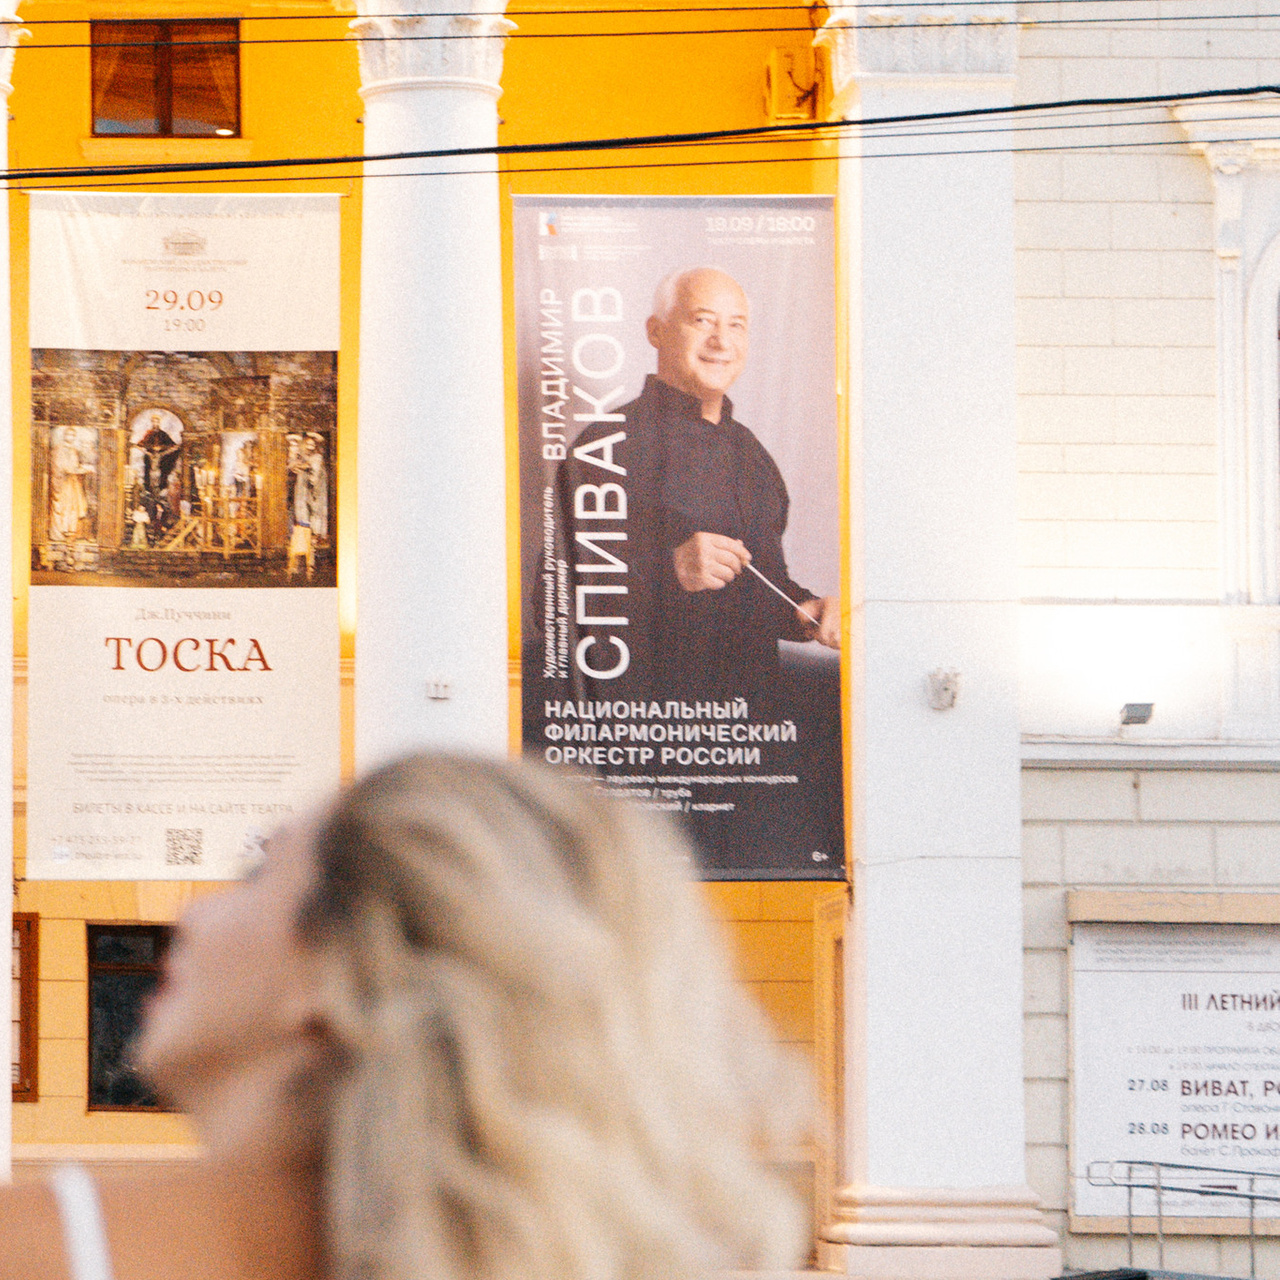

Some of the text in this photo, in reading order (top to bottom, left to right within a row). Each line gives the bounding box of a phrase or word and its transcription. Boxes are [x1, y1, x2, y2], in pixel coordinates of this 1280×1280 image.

[145, 289, 224, 311] 29.09
[163, 318, 206, 333] 19:00
[540, 288, 569, 460] ВЛАДИМИР
[572, 287, 630, 679] СПИВАКОВ
[104, 638, 274, 672] ТОСКА
[545, 696, 749, 723] НАЦИОНАЛЬНЫЙ
[545, 718, 798, 744] ФИЛАРМОНИЧЕСКИЙ
[545, 745, 761, 766] ОРКЕСТР РОССИИ
[1128, 1079, 1280, 1100] 27.08 ВИВАТ, Р
[1128, 1122, 1170, 1136] 28.08
[1181, 1123, 1257, 1141] РОМЕО
